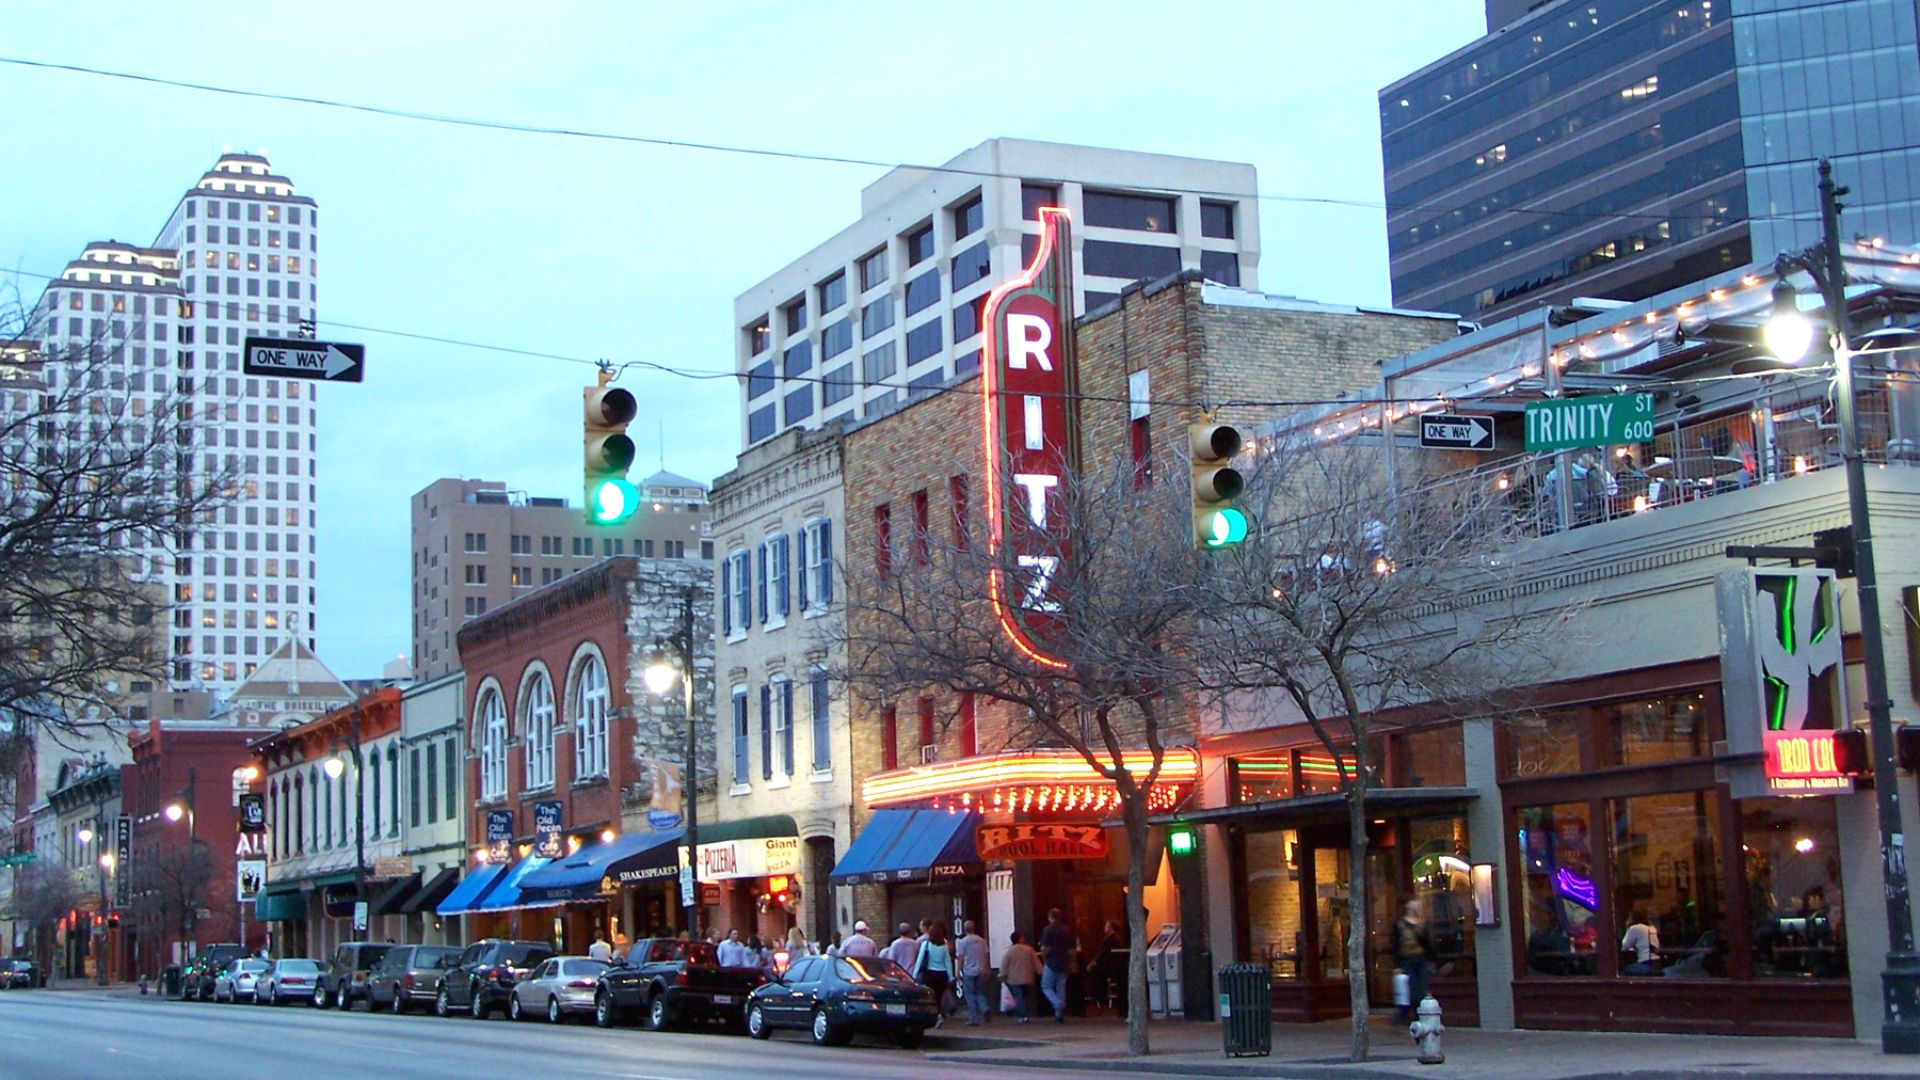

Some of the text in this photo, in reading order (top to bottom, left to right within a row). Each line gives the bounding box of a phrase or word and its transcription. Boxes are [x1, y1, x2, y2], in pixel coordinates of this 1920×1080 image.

[257, 349, 328, 369] ONE WAY
[1636, 394, 1653, 413] ST
[1527, 403, 1652, 444] TRINITY 600
[1428, 425, 1472, 439] ONE WAY
[1006, 313, 1063, 613] RITZ
[257, 701, 277, 711] THE
[1776, 738, 1811, 773] IRON
[540, 806, 557, 815] The
[492, 814, 508, 824] The
[536, 815, 554, 825] Old
[488, 823, 505, 833] Old
[536, 824, 562, 834] Pecan
[766, 839, 798, 849] Giant
[981, 824, 1101, 855] RITZ
[705, 843, 738, 877] PIZZERIA
[619, 865, 679, 881] SHAKESPEARE'S
[935, 865, 965, 876] PIZZA
